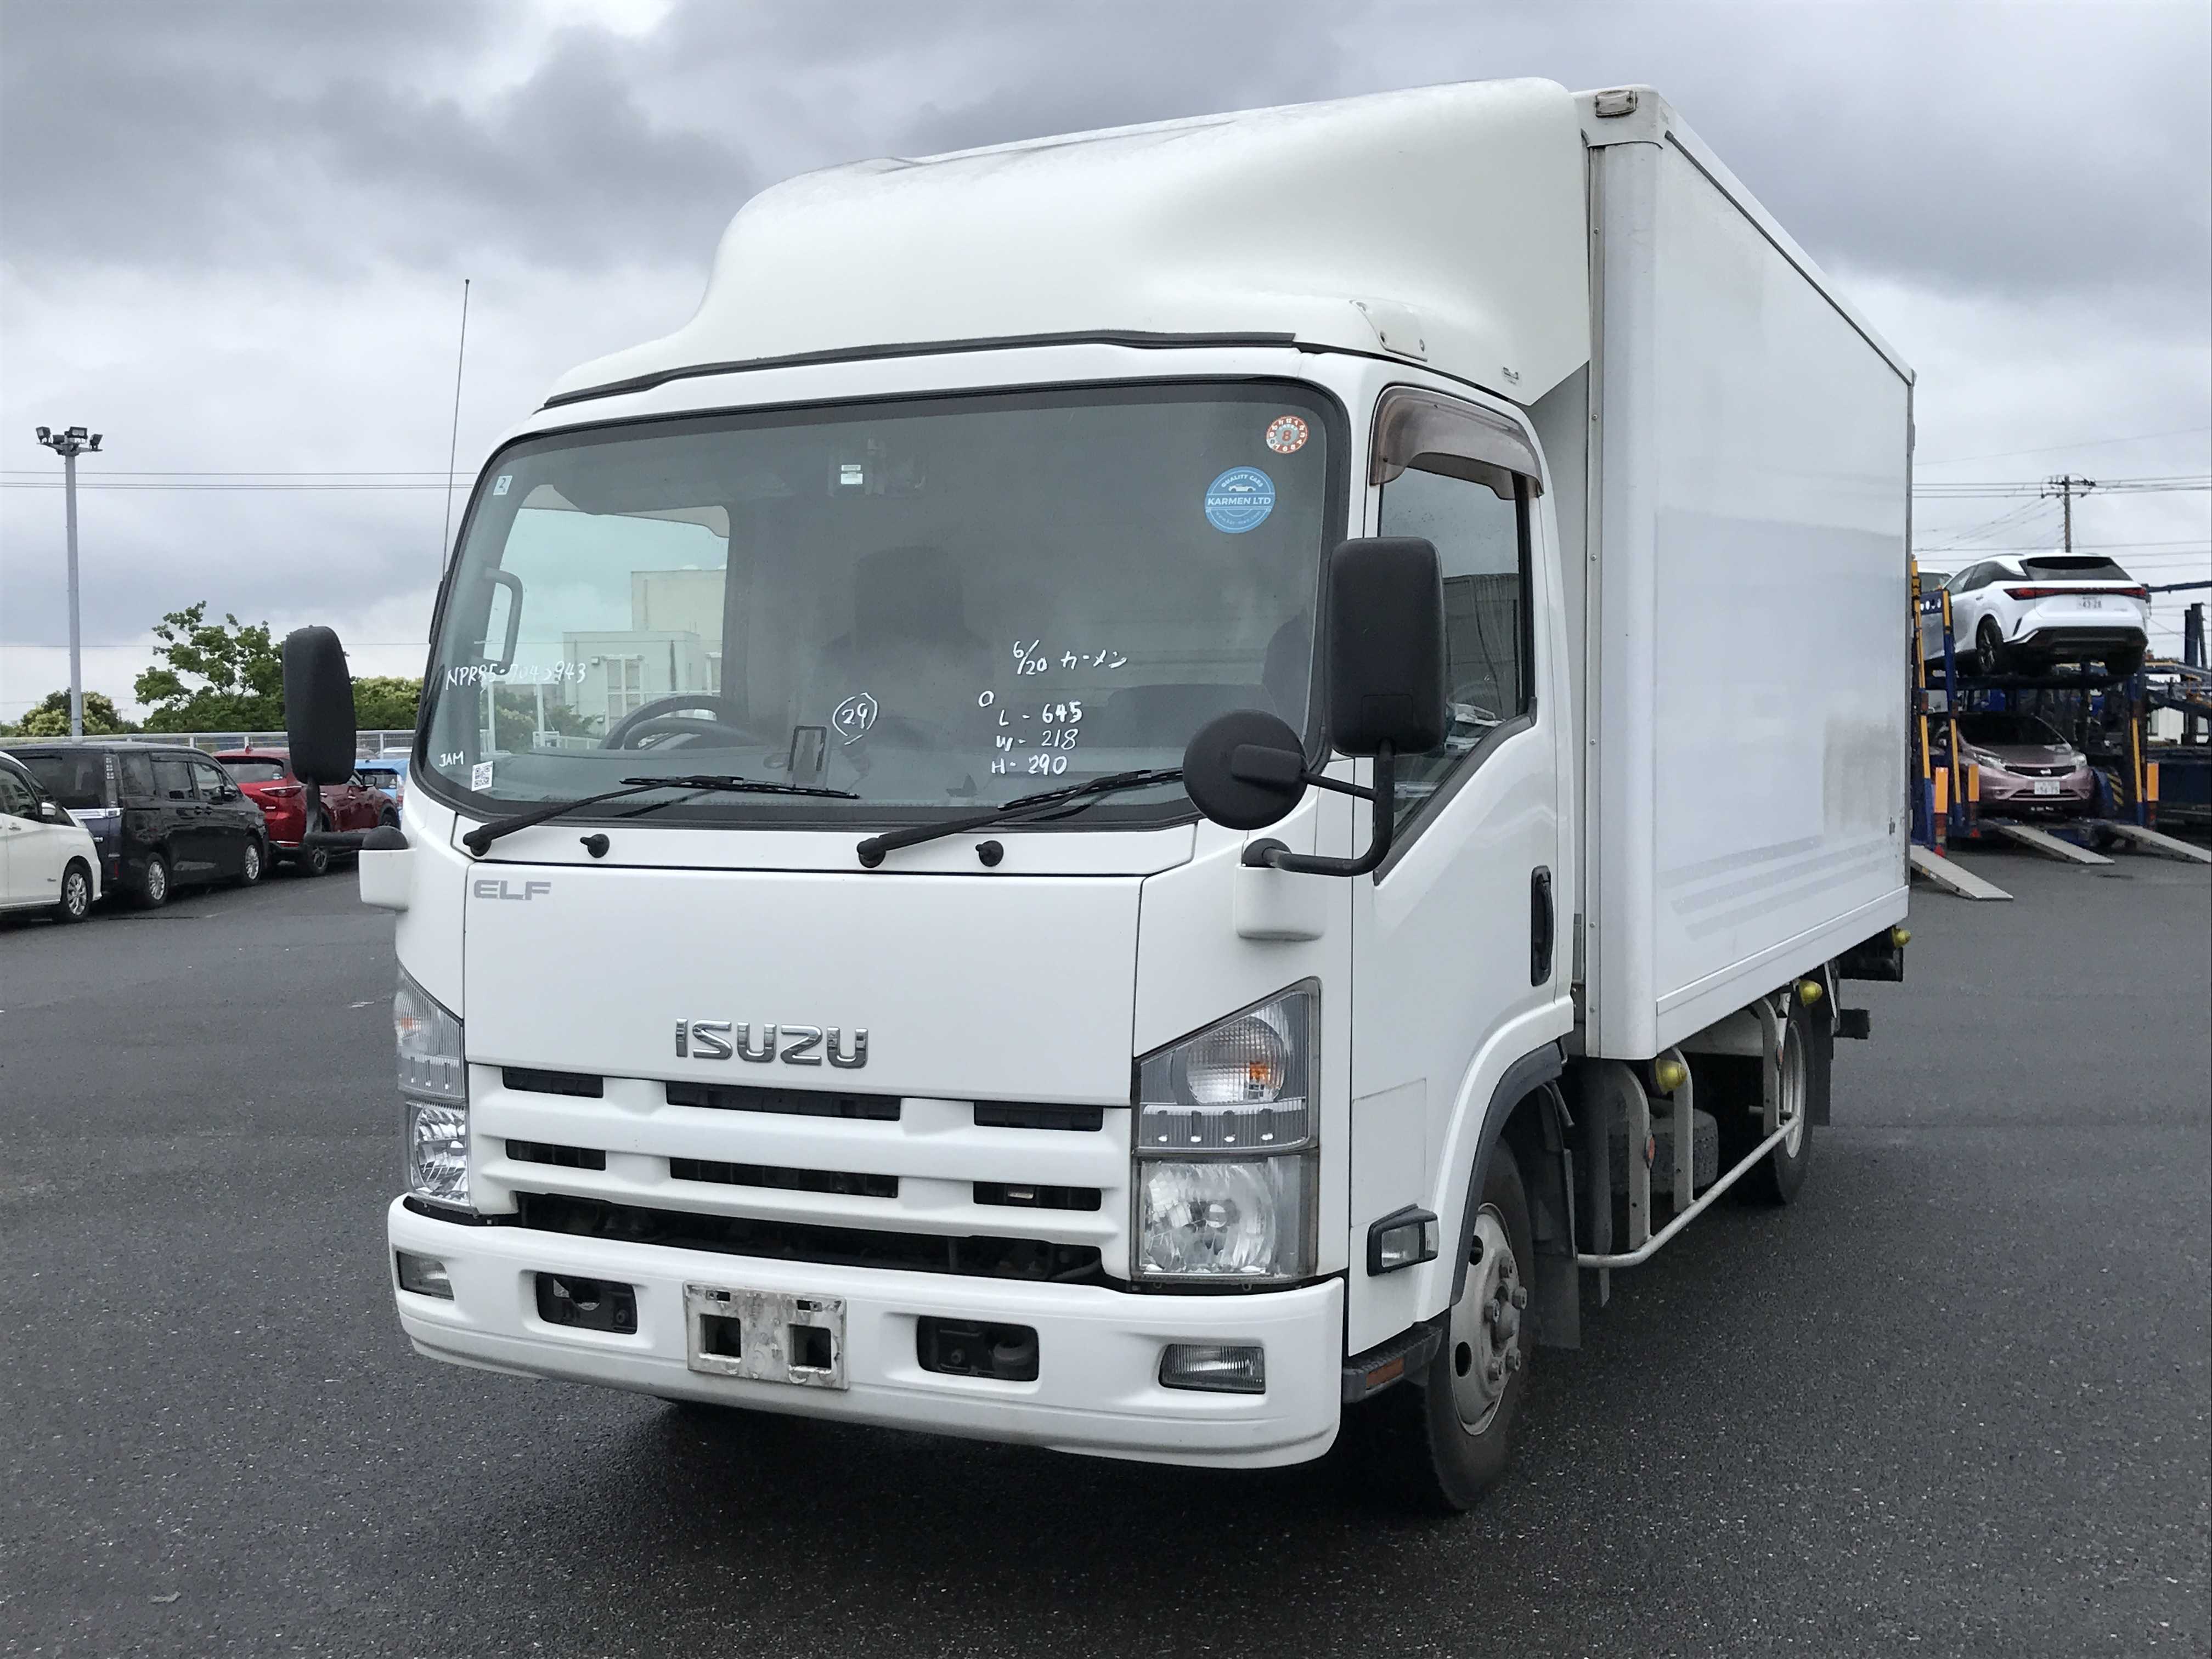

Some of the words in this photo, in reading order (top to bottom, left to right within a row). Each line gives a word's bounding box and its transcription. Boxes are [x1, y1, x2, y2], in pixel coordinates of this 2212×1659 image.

[1282, 430, 1292, 442] 8
[499, 477, 506, 488] 2
[1221, 474, 1248, 487] QUALITY
[1249, 476, 1263, 487] CARS
[1207, 497, 1251, 505] KARMEN
[1252, 496, 1271, 505] LTD
[1013, 639, 1047, 675] 6/20
[999, 709, 1009, 726] L
[1042, 701, 1082, 724] 645
[1041, 729, 1079, 751] 218
[439, 751, 464, 767] JAM
[1028, 753, 1068, 776] 290
[474, 879, 551, 900] ELF
[676, 1018, 868, 1069] ISUZU
